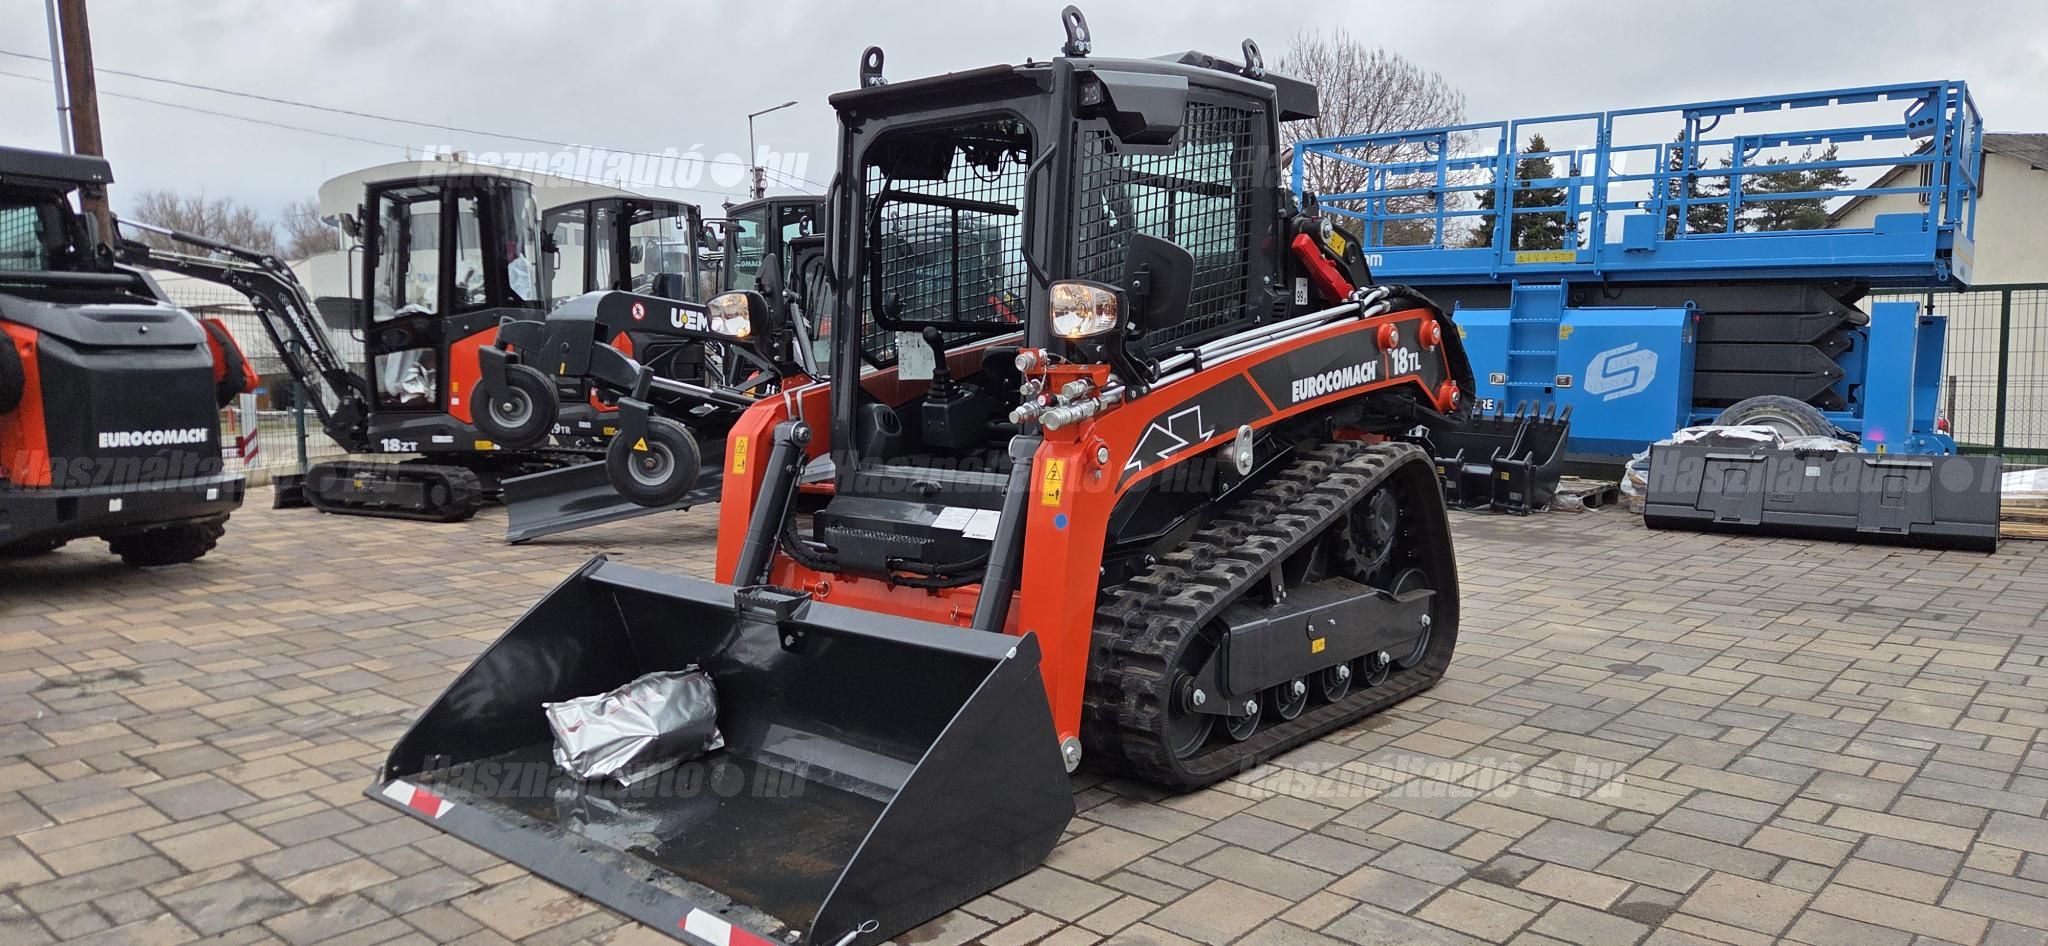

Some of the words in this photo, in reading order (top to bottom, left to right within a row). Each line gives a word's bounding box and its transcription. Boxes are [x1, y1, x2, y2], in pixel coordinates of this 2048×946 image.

[1391, 346, 1422, 376] 18TL
[1291, 359, 1378, 403] EUROCOMACH
[98, 427, 209, 449] EUROCOMACH
[380, 438, 419, 452] 18ZT
